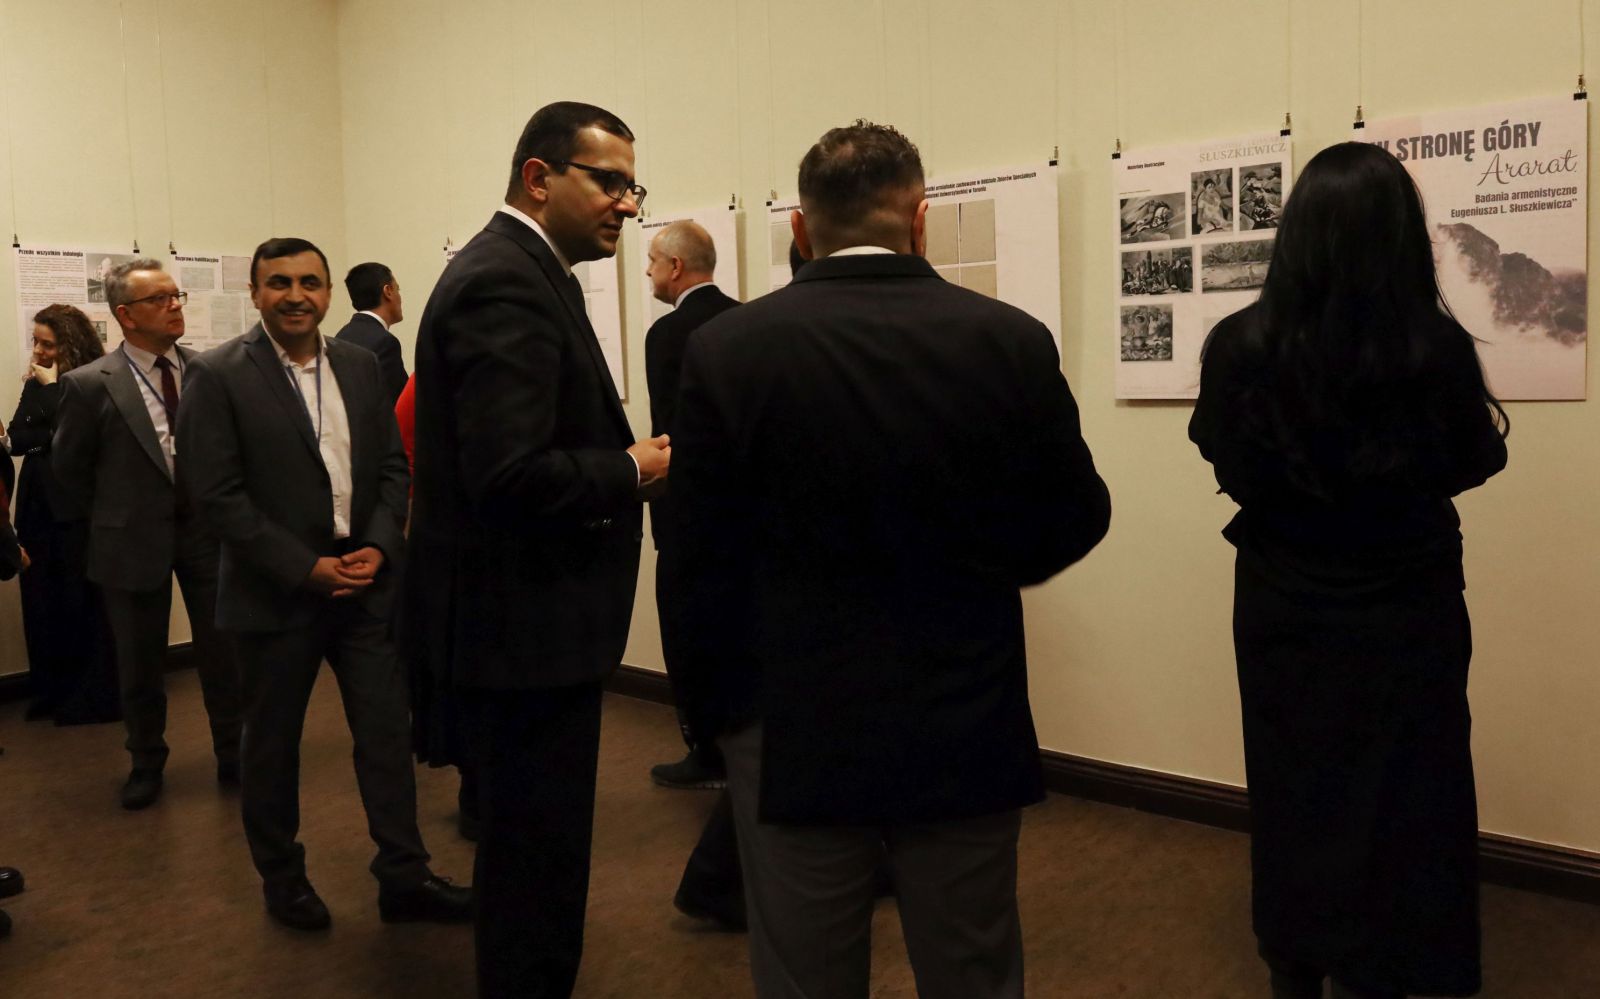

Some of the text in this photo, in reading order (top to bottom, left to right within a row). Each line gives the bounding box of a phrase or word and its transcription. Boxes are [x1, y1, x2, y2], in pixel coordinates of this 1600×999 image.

[1396, 119, 1541, 162] STRONĘ GÓRY
[1200, 143, 1286, 163] SŁUSZKIEWICZ
[1475, 186, 1578, 204] Badania armenistyczne
[1451, 204, 1498, 218] Eugeniusza
